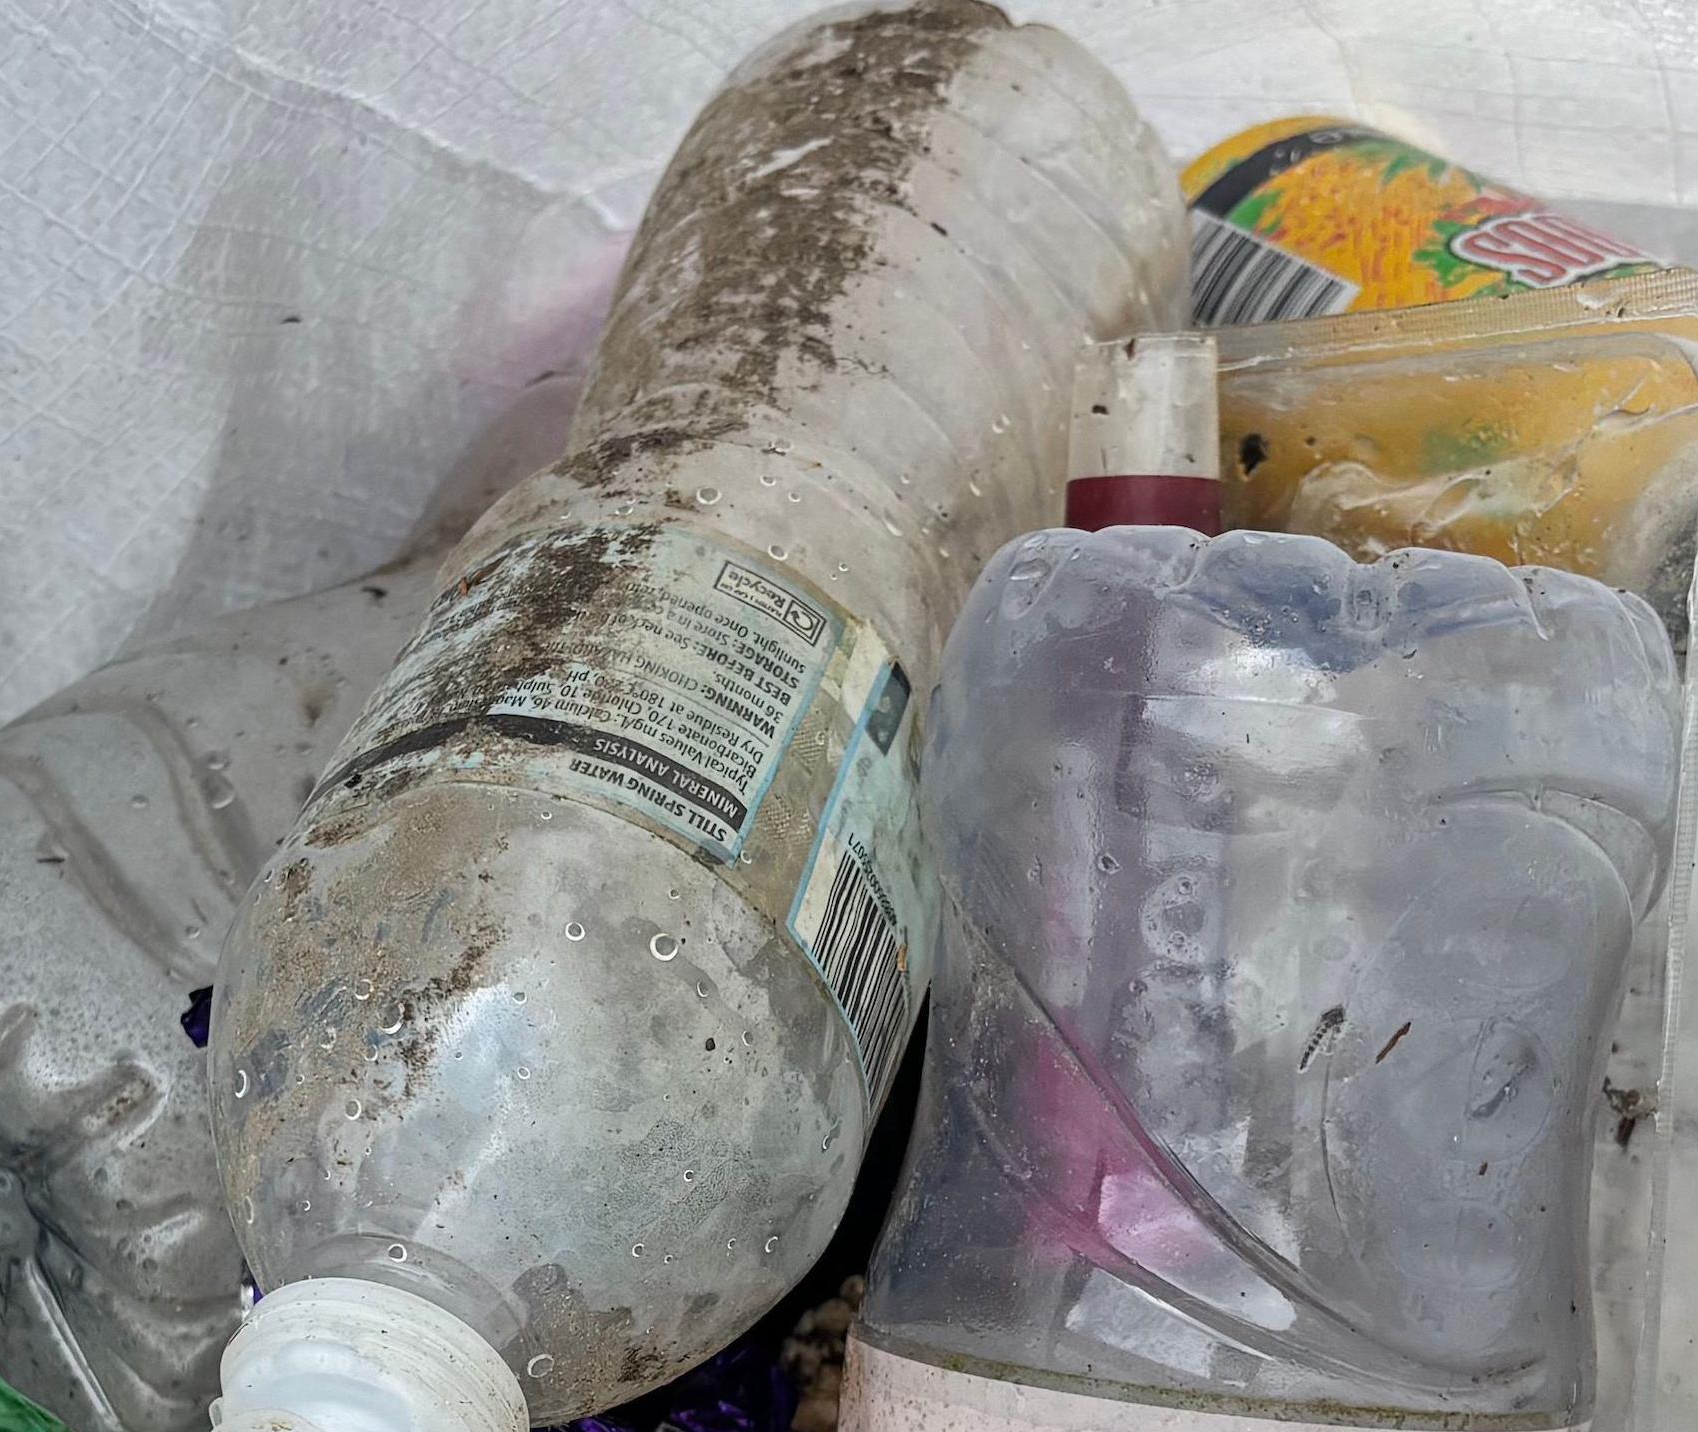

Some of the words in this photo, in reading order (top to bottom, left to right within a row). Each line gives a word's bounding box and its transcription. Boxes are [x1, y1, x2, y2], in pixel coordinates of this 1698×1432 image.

[727, 570, 786, 608] Recycle
[663, 629, 690, 650] See
[692, 620, 729, 644] Store
[713, 613, 749, 638] Once
[691, 640, 754, 680] BEFORE:
[730, 638, 801, 689] STORAGE:
[748, 629, 806, 675] sunlight.
[565, 669, 589, 683] pH
[633, 654, 698, 691] CHOKING
[527, 694, 551, 711] 46,
[557, 683, 578, 698] 10,
[582, 686, 642, 716] Chloride
[710, 670, 765, 708] months.
[754, 674, 791, 705] BEST
[553, 698, 611, 722] Calcium
[644, 705, 674, 729] 170,
[669, 700, 684, 714] at
[699, 683, 776, 738] WARNING:
[763, 703, 784, 724] 36
[613, 711, 657, 737] mg/L:
[686, 707, 740, 745] Residue
[592, 737, 669, 775] ANALYSIS
[658, 731, 704, 764] Values
[677, 723, 757, 776] Bicarbonate
[739, 734, 763, 763] Dry
[568, 757, 624, 785] WATER
[703, 756, 748, 795] Typical
[625, 776, 686, 817] SPRING
[669, 769, 738, 818] MINERAL
[686, 808, 727, 842] STILL
